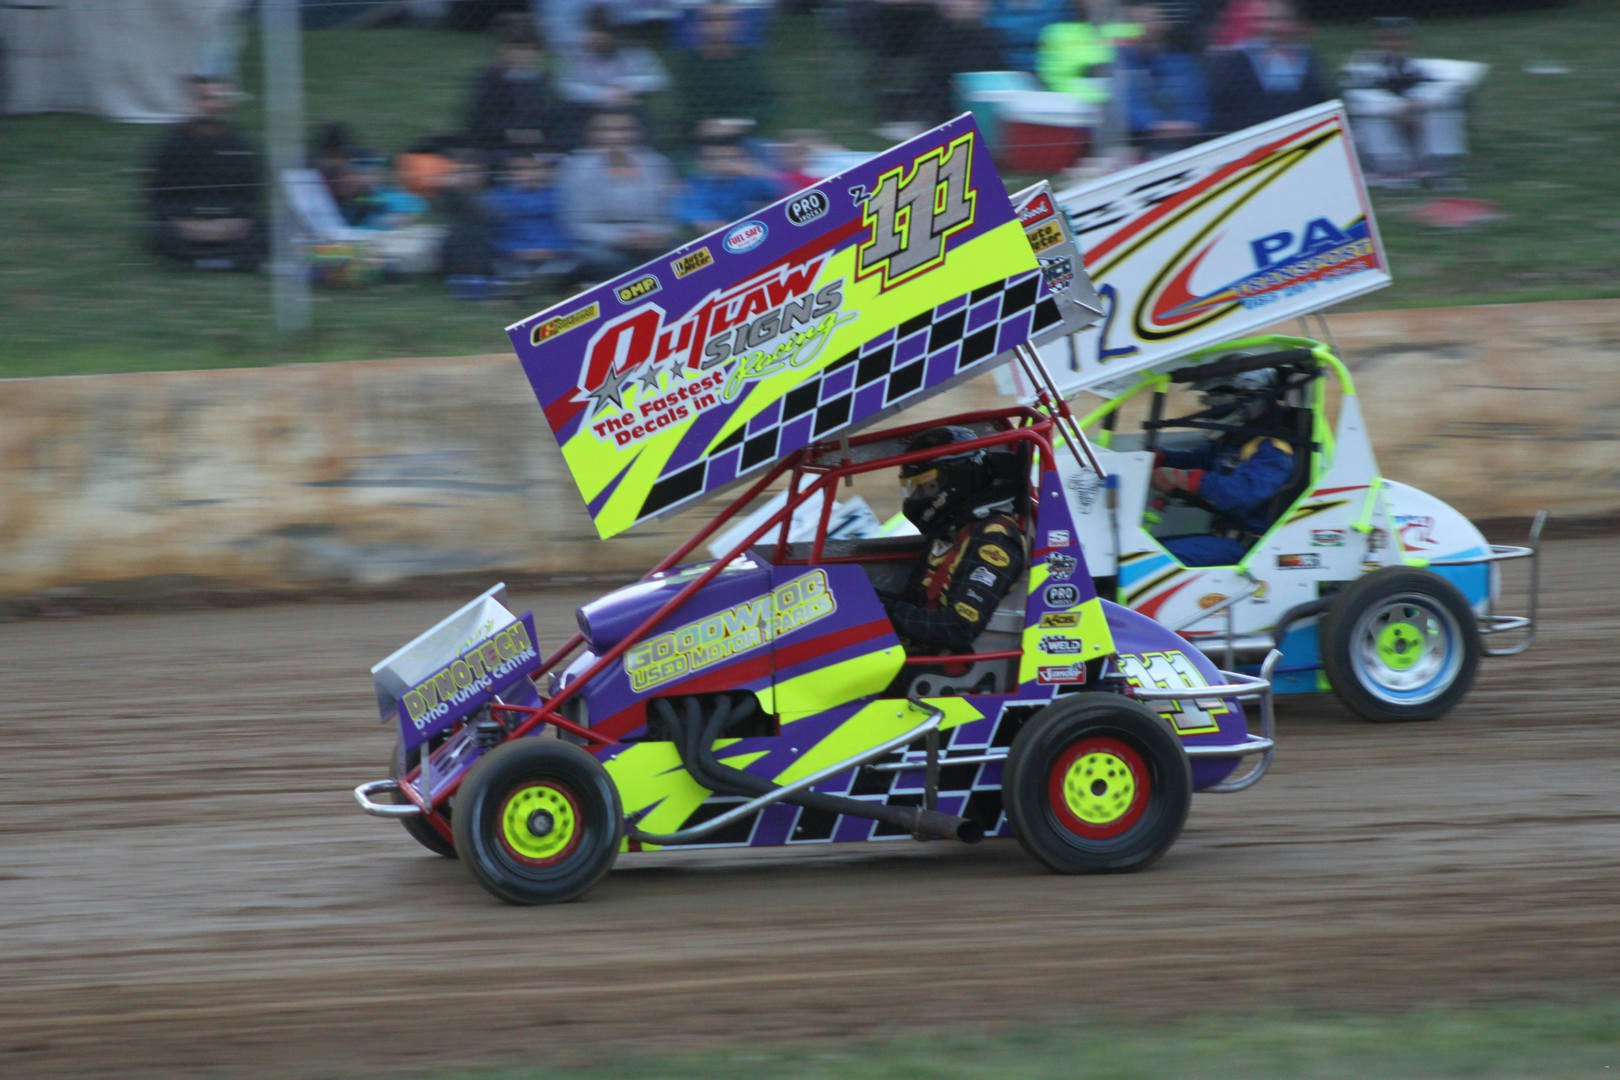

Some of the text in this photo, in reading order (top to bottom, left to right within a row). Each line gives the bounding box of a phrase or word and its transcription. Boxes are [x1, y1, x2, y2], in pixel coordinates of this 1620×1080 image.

[728, 232, 745, 247] FUEL
[745, 224, 763, 239] SAFE
[791, 194, 820, 218] PRO
[856, 132, 976, 292] 111
[1249, 217, 1347, 269] PA
[619, 277, 655, 301] OMP
[701, 278, 843, 371] SIGNS
[723, 311, 857, 400] Racing
[592, 370, 724, 438] The Fastest
[615, 392, 717, 447] Decals in
[626, 570, 828, 672] GOODWOOD
[1049, 587, 1074, 600] PRO
[402, 620, 532, 721] DYNOTECH
[631, 652, 690, 691] USED
[690, 626, 762, 670] MOTOR
[1048, 640, 1081, 650] WELD
[1116, 650, 1230, 735] 111
